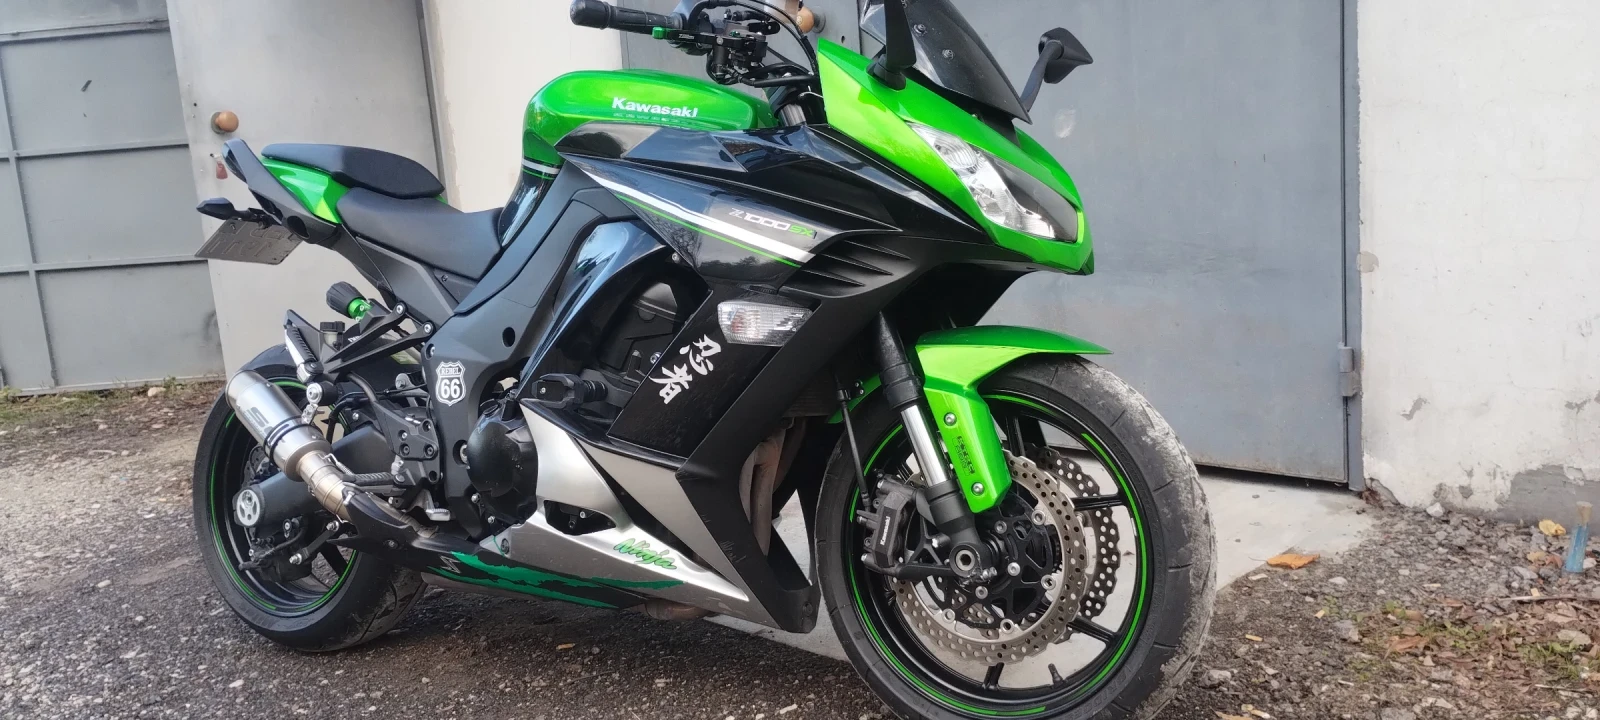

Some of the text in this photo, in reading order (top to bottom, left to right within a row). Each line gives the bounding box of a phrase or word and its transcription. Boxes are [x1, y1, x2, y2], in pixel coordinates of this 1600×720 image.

[611, 96, 699, 118] Kawasaki
[440, 367, 461, 375] REBEL
[648, 333, 722, 405] 忍者
[440, 378, 460, 399] 66
[613, 538, 678, 570] Ninja
